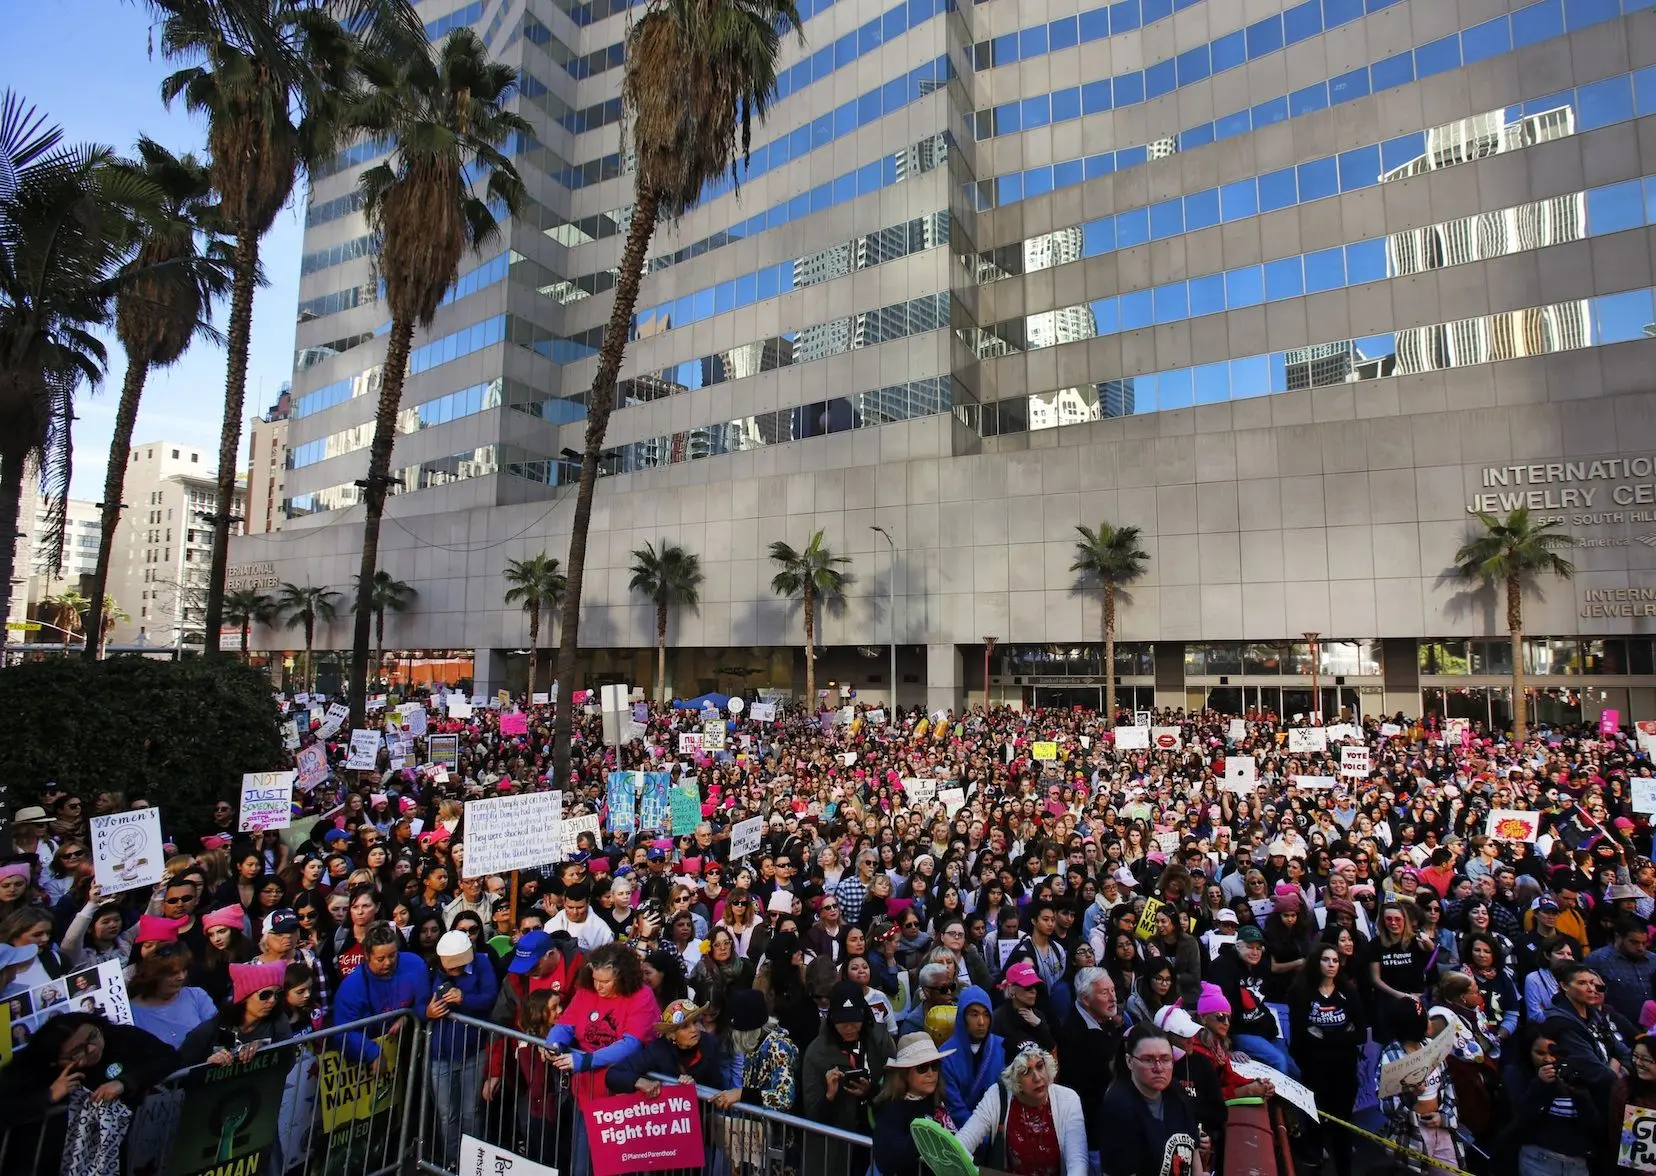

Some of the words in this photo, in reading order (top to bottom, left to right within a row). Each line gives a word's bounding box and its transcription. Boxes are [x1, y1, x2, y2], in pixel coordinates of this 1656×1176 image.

[1482, 457, 1656, 488] INTERNATIO
[1466, 487, 1597, 514] JEWELRY
[1612, 483, 1656, 506] CE
[1572, 512, 1624, 526] SOUTH
[1579, 538, 1631, 548] America
[1346, 752, 1368, 760] VOTE
[1342, 763, 1367, 771] VOICE
[253, 773, 283, 786] NOT
[244, 788, 288, 801] JUST
[242, 801, 289, 812] SOMEONE'S
[94, 808, 156, 828] Women's
[610, 812, 632, 827] HER
[642, 814, 663, 829] HER
[468, 832, 487, 844] They
[1390, 958, 1413, 967] FEMALE
[1308, 1012, 1346, 1024] PERSISTED
[1320, 1010, 1334, 1018] SHE
[204, 1062, 240, 1084] FIGHT
[243, 1054, 268, 1073] LIKE
[271, 1052, 279, 1066] A
[592, 1101, 666, 1125] Together
[667, 1097, 692, 1113] We
[600, 1124, 643, 1145] Fight
[645, 1120, 668, 1137] for
[670, 1117, 691, 1135] All
[627, 1152, 648, 1160] Planned
[648, 1149, 677, 1158] Parenthood
